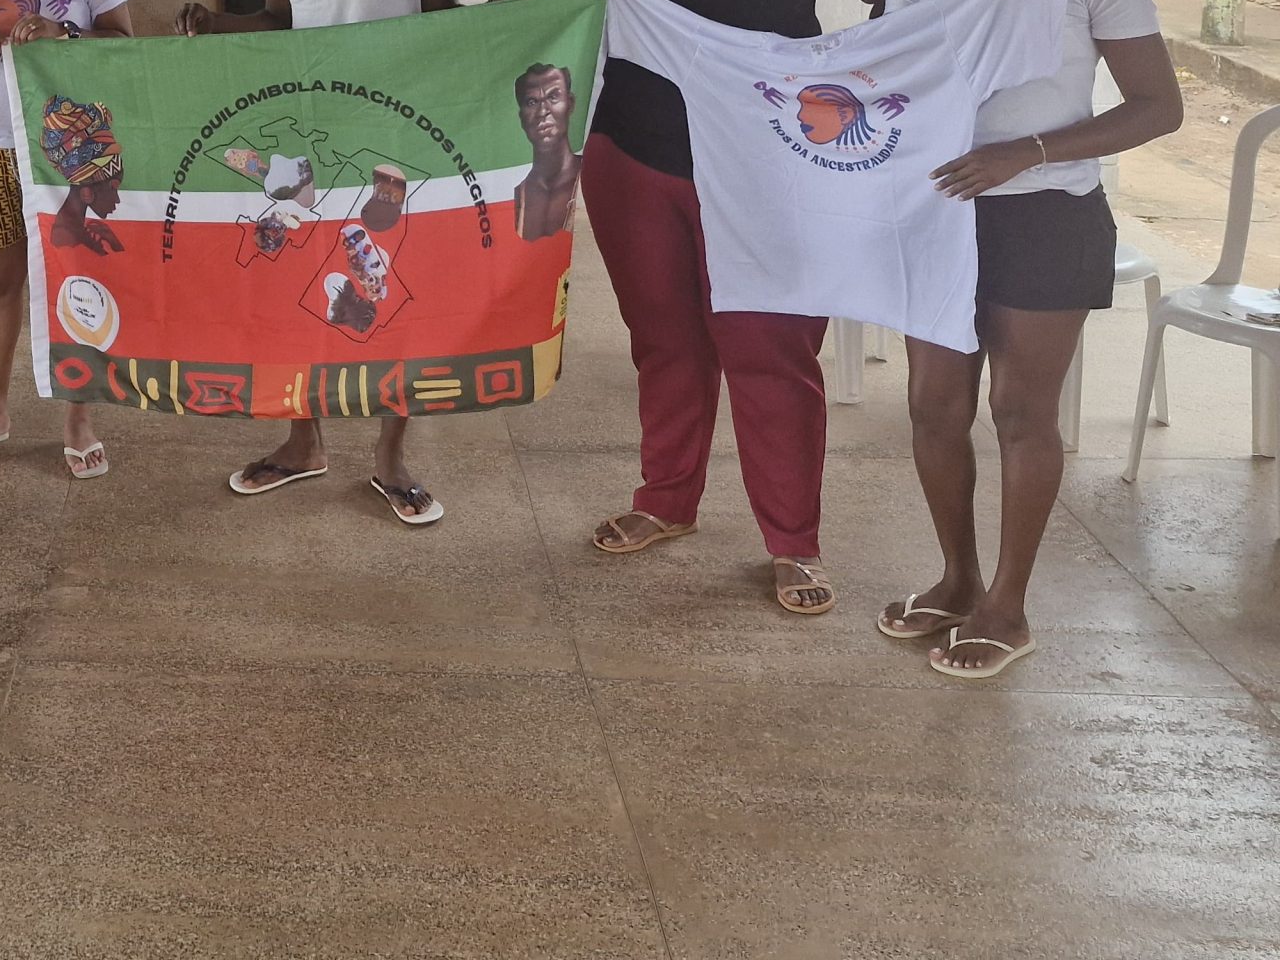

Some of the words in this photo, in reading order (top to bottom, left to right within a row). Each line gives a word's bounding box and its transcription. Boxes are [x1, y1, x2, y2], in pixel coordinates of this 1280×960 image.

[163, 138, 203, 263] TERRITÓRIO
[200, 80, 327, 140] QUILOMBOLA
[331, 80, 415, 119] RIACHO
[416, 115, 455, 154] DOS
[452, 152, 492, 248] NEGROS
[769, 118, 792, 143] FIOS
[791, 142, 809, 158] DA
[810, 127, 902, 172] ANCESTRALIDADE
